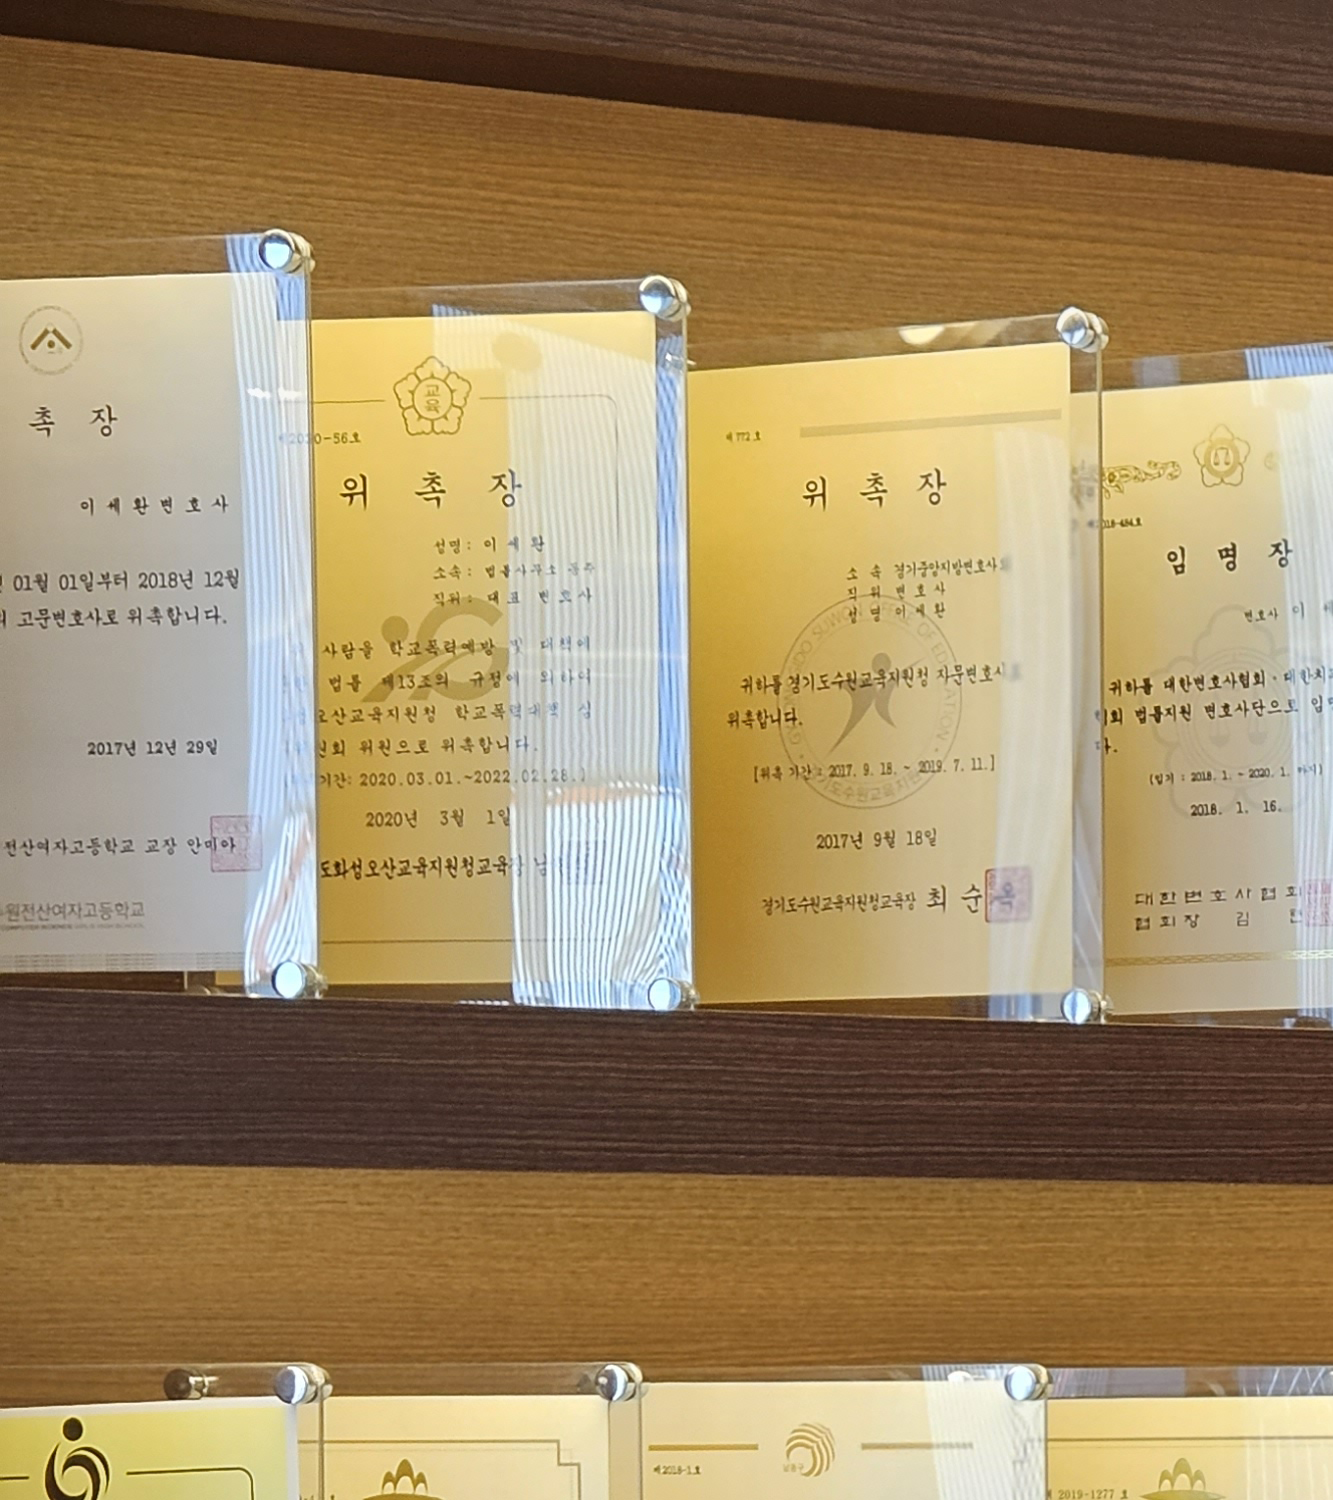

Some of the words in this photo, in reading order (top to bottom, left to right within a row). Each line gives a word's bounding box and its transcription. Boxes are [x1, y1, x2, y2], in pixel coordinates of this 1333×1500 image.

[14, 572, 48, 593] 01월
[58, 571, 128, 591] 01일부터
[138, 570, 194, 591] 2018년
[203, 569, 241, 591] 12월
[17, 605, 119, 628] 고문변호사로
[127, 603, 226, 626] 위촉합니다.
[741, 674, 781, 695] 귀하를
[1109, 677, 1153, 697] 귀하를
[1164, 670, 1266, 691] 대한변호사협회
[728, 707, 803, 729] 위촉합니다.
[1135, 704, 1191, 726] 법률지원
[1205, 698, 1298, 721] 변호사단으로
[87, 739, 136, 757] 2017년
[187, 738, 219, 756] 29일
[366, 811, 418, 828] 2020년
[440, 809, 464, 827] 3월
[145, 837, 178, 855] 교장
[817, 831, 862, 850] 2017년
[874, 830, 896, 849] 9월
[907, 828, 937, 847] 18일
